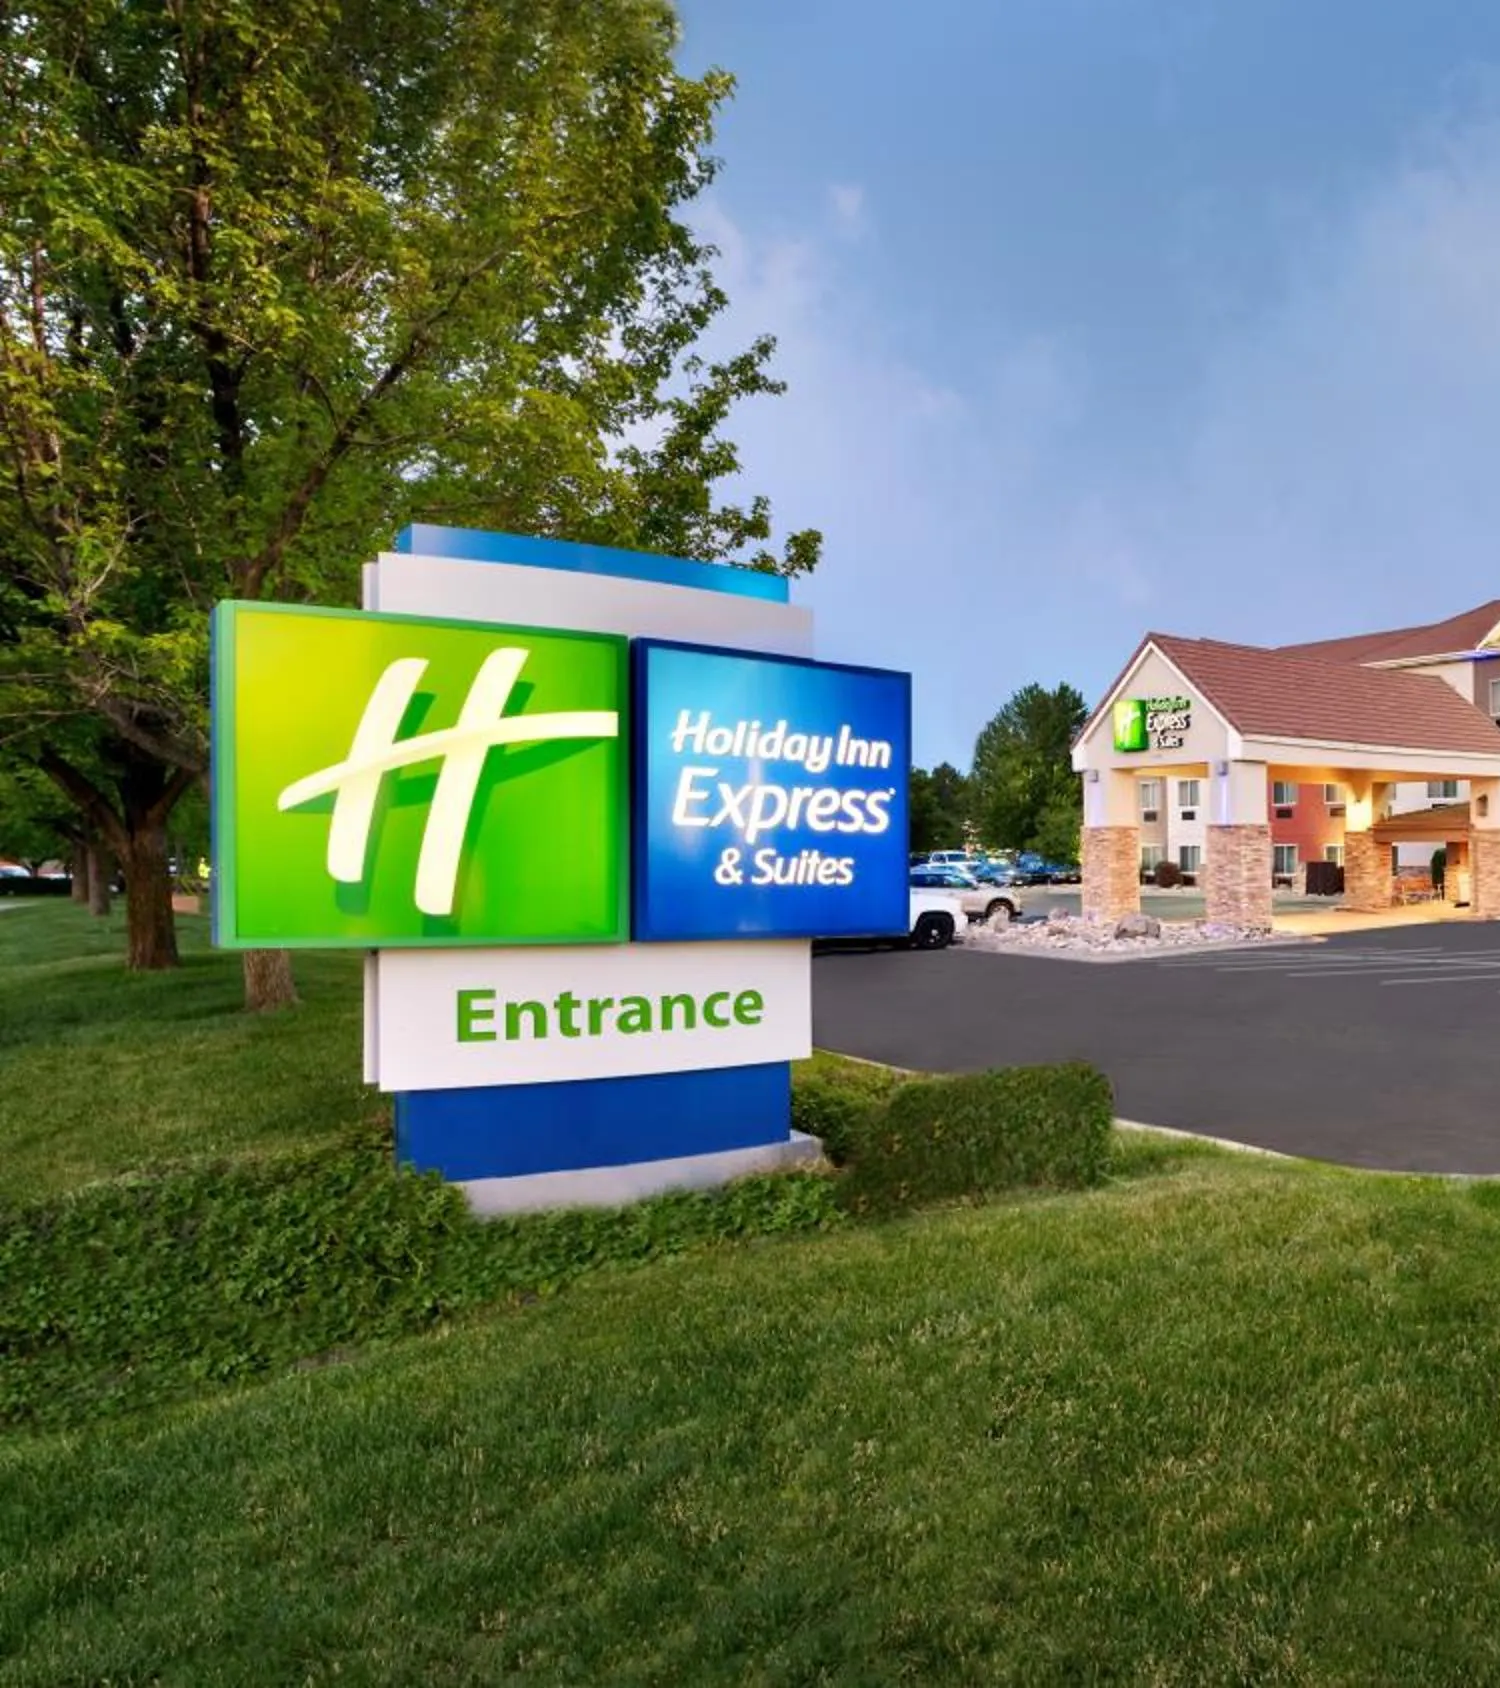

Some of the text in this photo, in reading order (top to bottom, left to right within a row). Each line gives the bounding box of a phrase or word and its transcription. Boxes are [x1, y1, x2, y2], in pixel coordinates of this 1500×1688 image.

[671, 709, 892, 773] Holiday Inn
[277, 646, 619, 915] H
[672, 766, 893, 844] Express
[714, 848, 855, 885] & Suites
[456, 988, 765, 1042] Entrance
